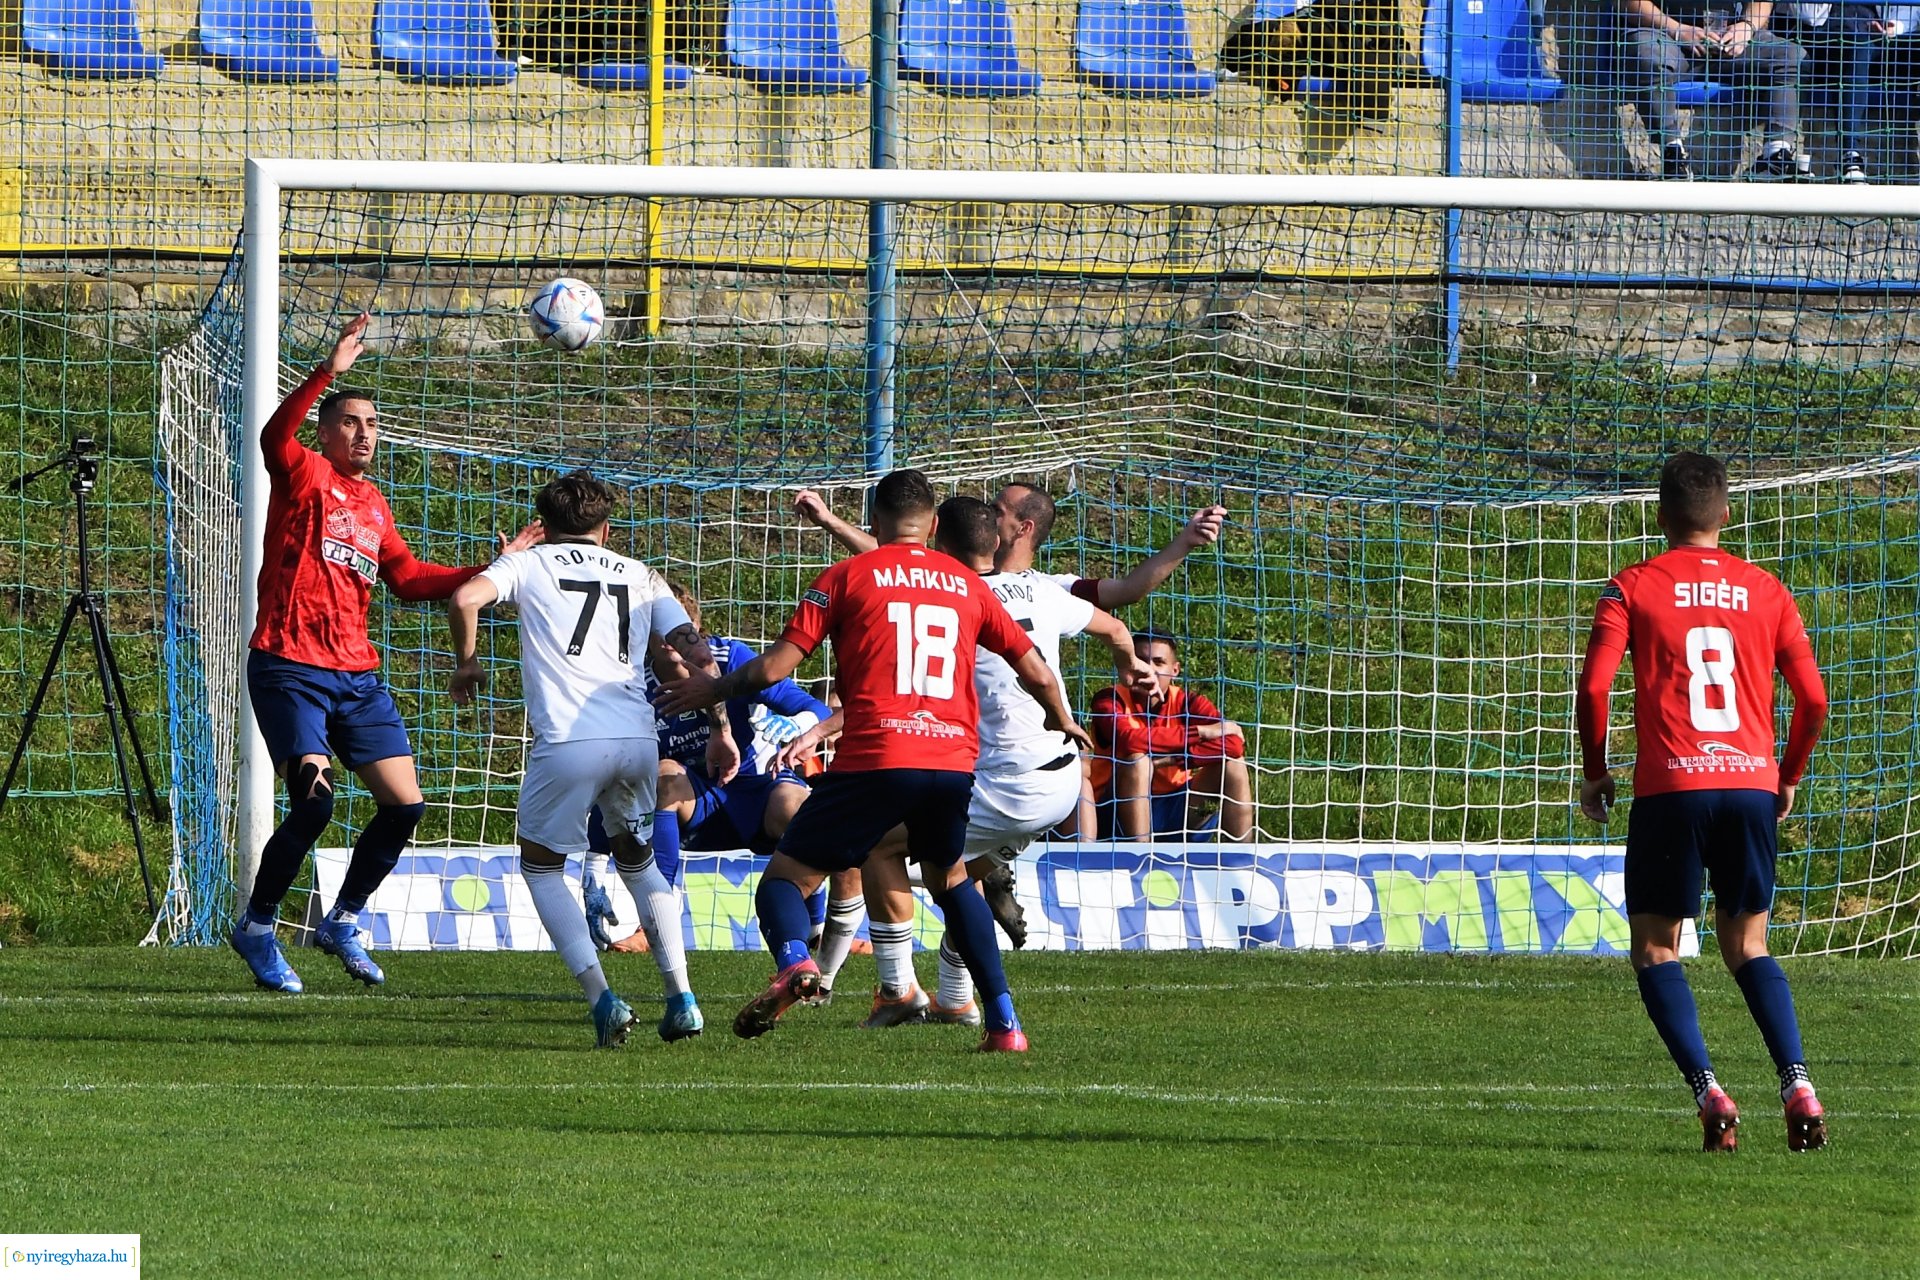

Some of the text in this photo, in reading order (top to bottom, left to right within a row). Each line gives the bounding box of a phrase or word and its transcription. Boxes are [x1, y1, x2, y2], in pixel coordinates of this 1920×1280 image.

[873, 564, 968, 597] MÁRKUS
[992, 584, 1034, 603] OROG
[1674, 578, 1749, 611] SIGÉR
[558, 578, 631, 664] 71
[887, 601, 959, 700] 18
[1685, 626, 1740, 732] 8
